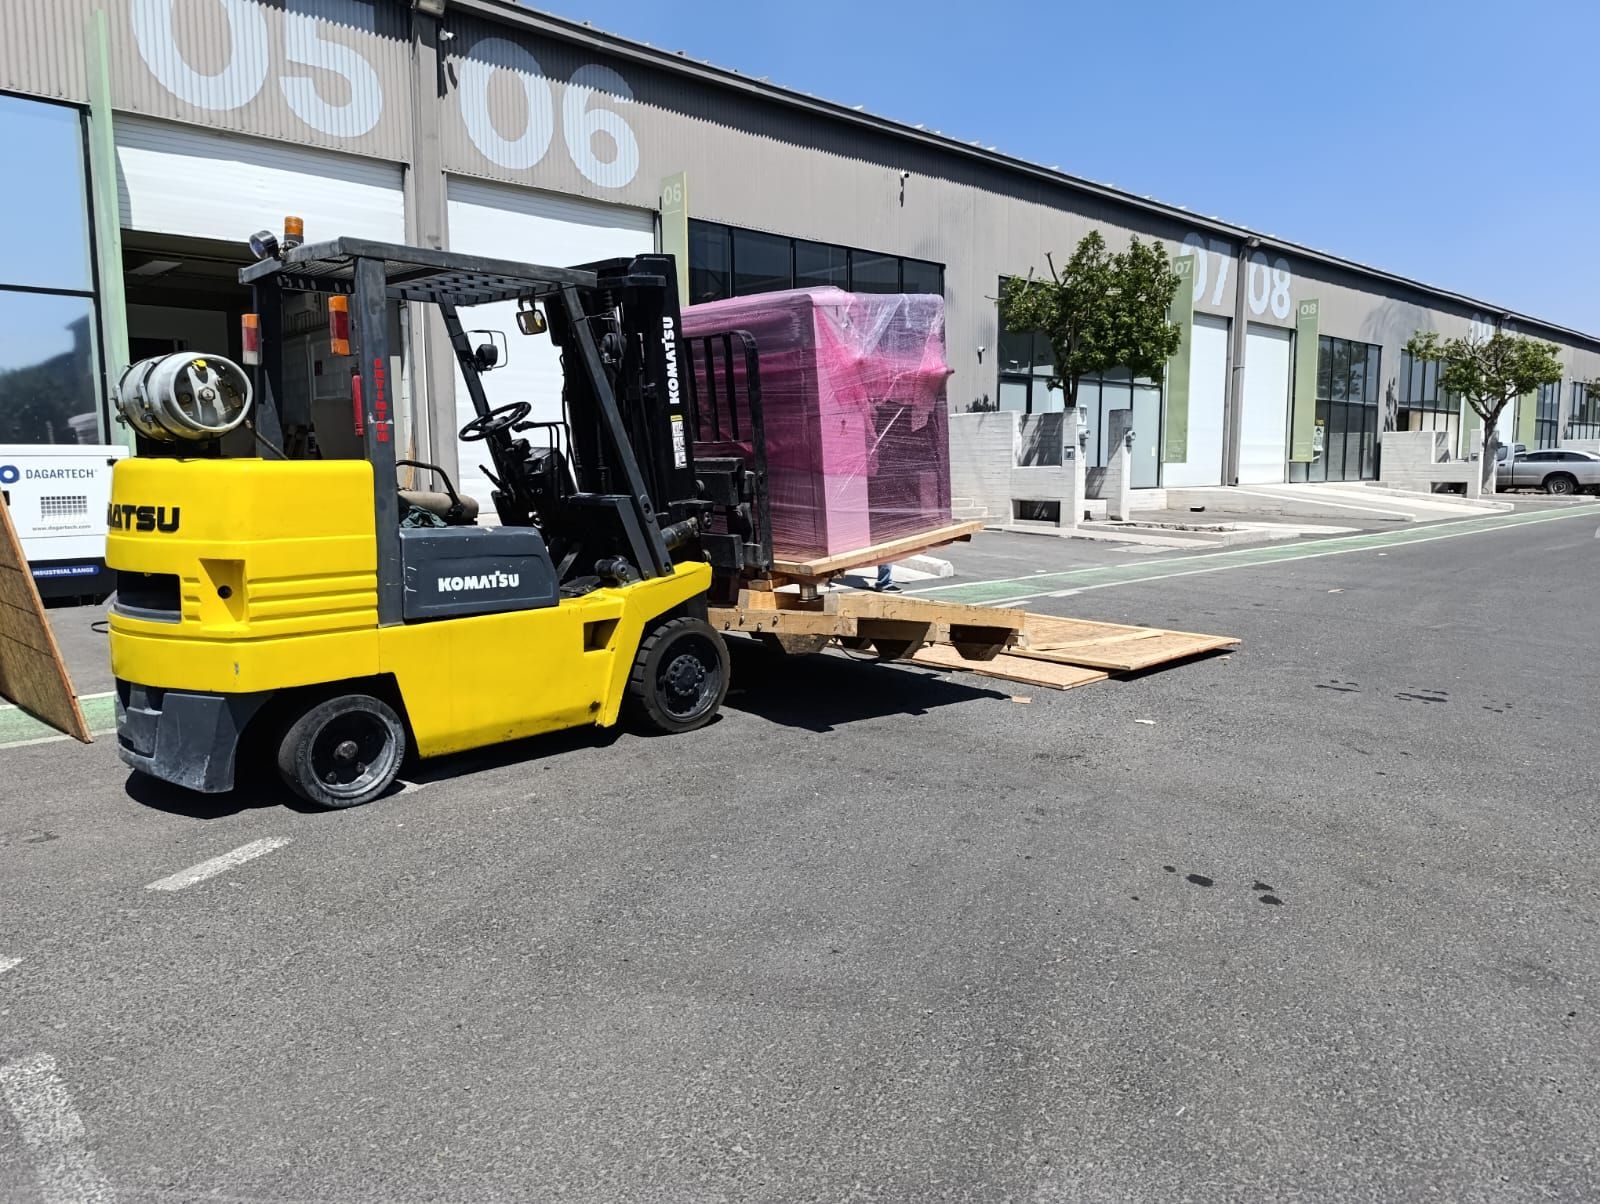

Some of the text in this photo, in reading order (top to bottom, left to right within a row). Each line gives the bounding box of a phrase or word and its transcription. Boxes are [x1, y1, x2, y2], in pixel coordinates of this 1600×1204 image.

[131, 0, 383, 138] 05
[460, 37, 640, 188] 06
[663, 183, 682, 206] 06
[1174, 261, 1192, 275] 07
[1247, 251, 1291, 319] 08
[1300, 303, 1317, 315] 08
[661, 316, 680, 405] KOMATSU
[25, 469, 94, 479] DAGARTECH
[437, 570, 520, 592] KOMATSU
